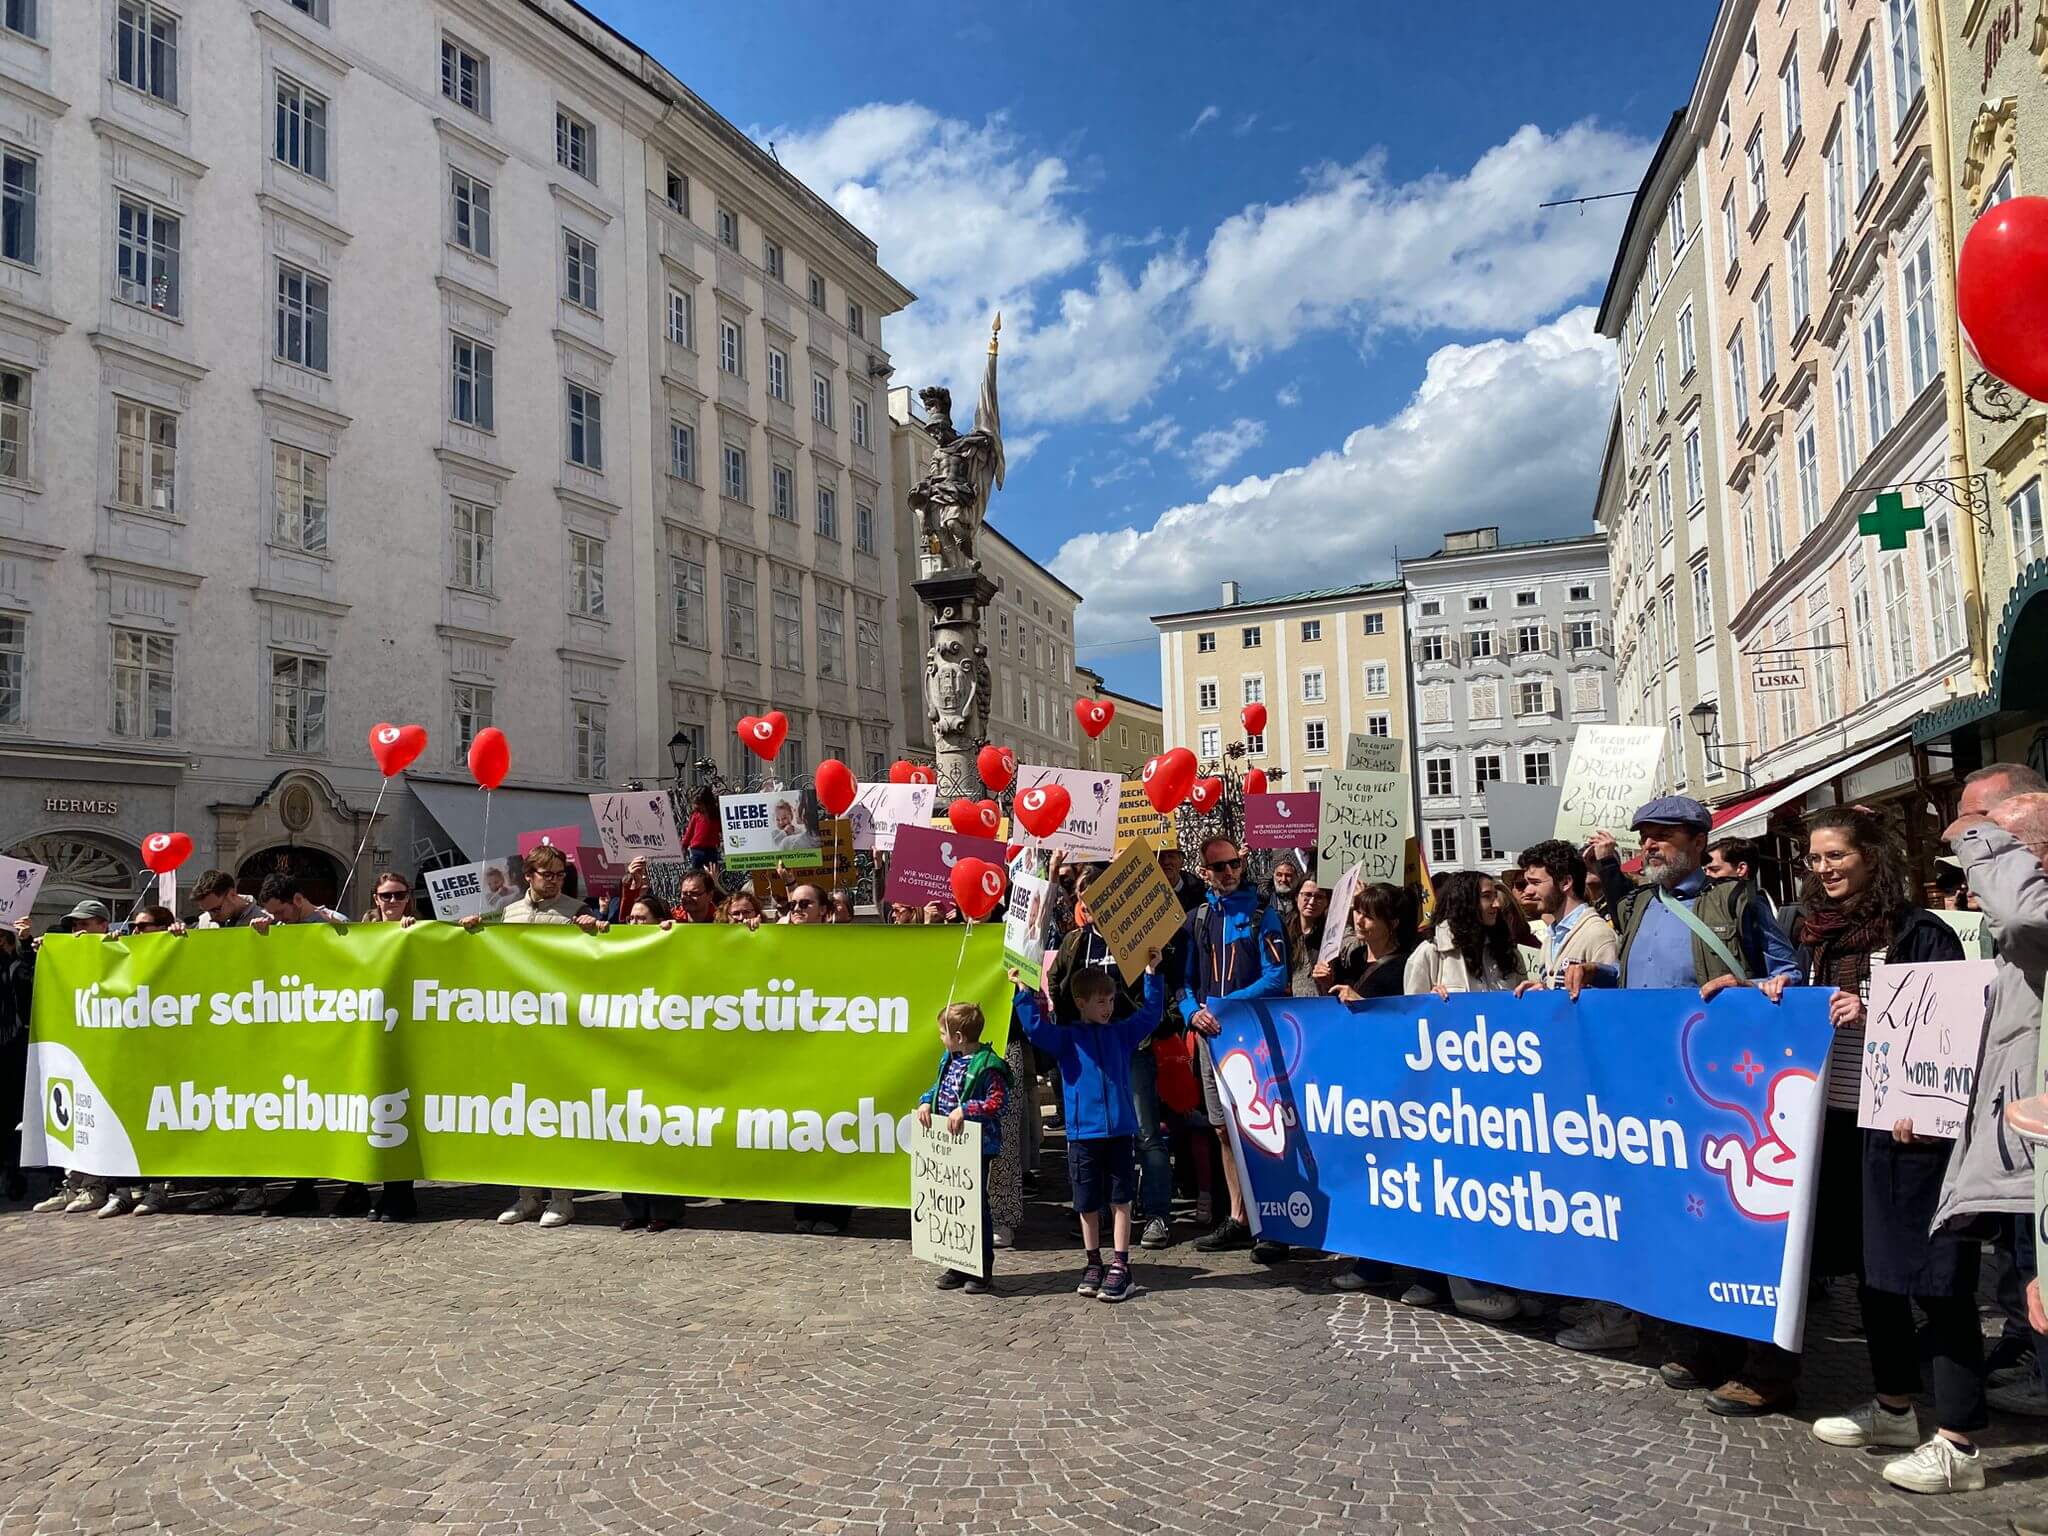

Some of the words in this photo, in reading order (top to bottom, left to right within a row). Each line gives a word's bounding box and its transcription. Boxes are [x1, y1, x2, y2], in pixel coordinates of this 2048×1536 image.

[1758, 674, 1800, 687] LISKA
[1351, 753, 1396, 771] DREAMS
[1573, 755, 1646, 780] DREAMS
[1333, 775, 1353, 792] You
[1588, 781, 1632, 801] YOUR
[46, 799, 118, 814] HERMES
[1348, 793, 1374, 804] YOUR
[725, 804, 769, 820] LIEBE
[728, 821, 741, 831] SIE
[743, 819, 769, 830] BEIDE
[1326, 802, 1399, 829] DREAMS
[1118, 829, 1135, 838] DER
[1343, 830, 1388, 850] YOUR
[903, 869, 916, 877] WIR
[917, 871, 946, 882] WOLLEN
[1341, 850, 1399, 879] BABY
[432, 873, 479, 893] LIEBE
[436, 891, 453, 902] SIE
[454, 885, 481, 898] BEIDE
[1013, 884, 1031, 909] LIEBE
[1118, 917, 1132, 934] VOR
[1130, 905, 1145, 922] DER
[1141, 881, 1164, 908] GEBURT
[1097, 909, 1113, 927] FÜR
[1110, 893, 1127, 914] ALLE
[1126, 932, 1145, 952] NACH
[1143, 918, 1156, 934] DER
[1153, 898, 1174, 922] GEBURT
[75, 981, 201, 1029] Kinder
[209, 975, 399, 1032] schützen,
[412, 979, 568, 1026] Frauen
[578, 978, 909, 1034] unterstützen
[1877, 970, 1938, 1067] Life
[1404, 1014, 1542, 1075] Jedes
[1903, 1061, 1939, 1089] worth
[1943, 1062, 1974, 1096] givin
[145, 1073, 410, 1148] Abtreibung
[424, 1082, 725, 1147] undenkbar
[1305, 1083, 1688, 1170] Menschenleben
[914, 1151, 974, 1191] DREAMS
[929, 1188, 966, 1216] YOUR
[1366, 1152, 1422, 1213] ist
[1433, 1158, 1622, 1242] kostbar
[929, 1212, 976, 1254] BABY
